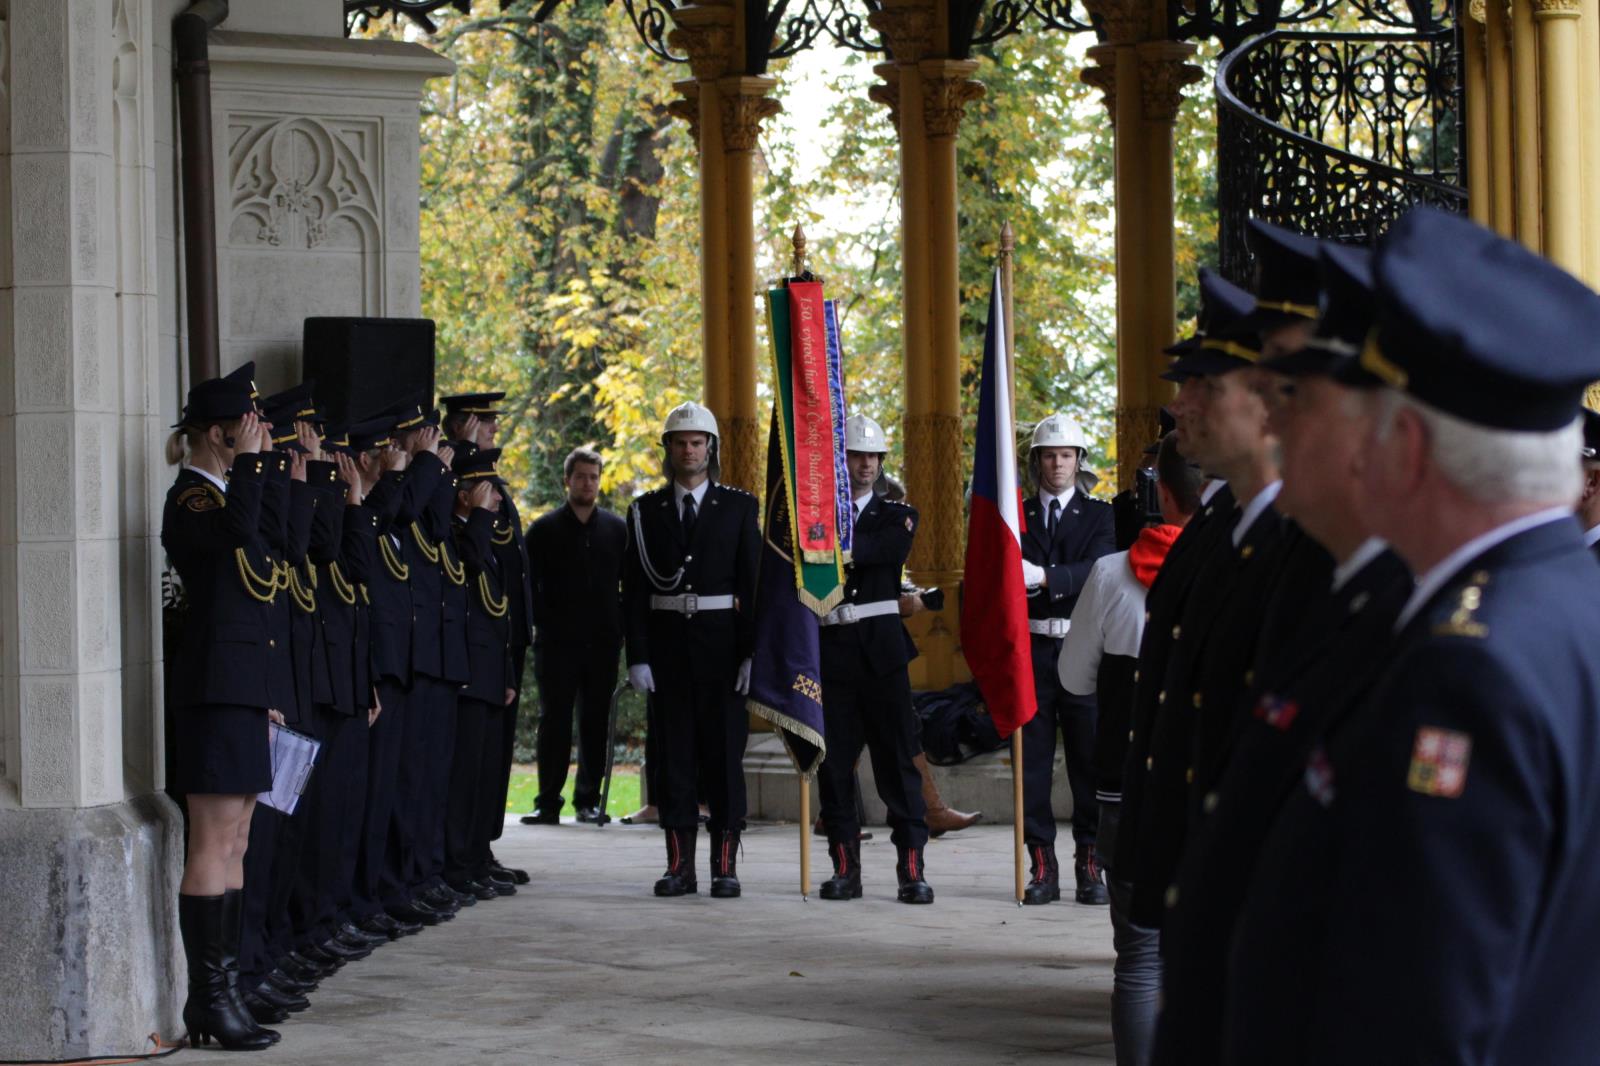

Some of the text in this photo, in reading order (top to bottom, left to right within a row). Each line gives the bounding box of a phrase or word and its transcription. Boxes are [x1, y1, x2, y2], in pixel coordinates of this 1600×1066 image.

[800, 298, 813, 321] 150.
[799, 328, 816, 364] výročí
[805, 411, 824, 447] České
[806, 452, 824, 518] Budějovice
